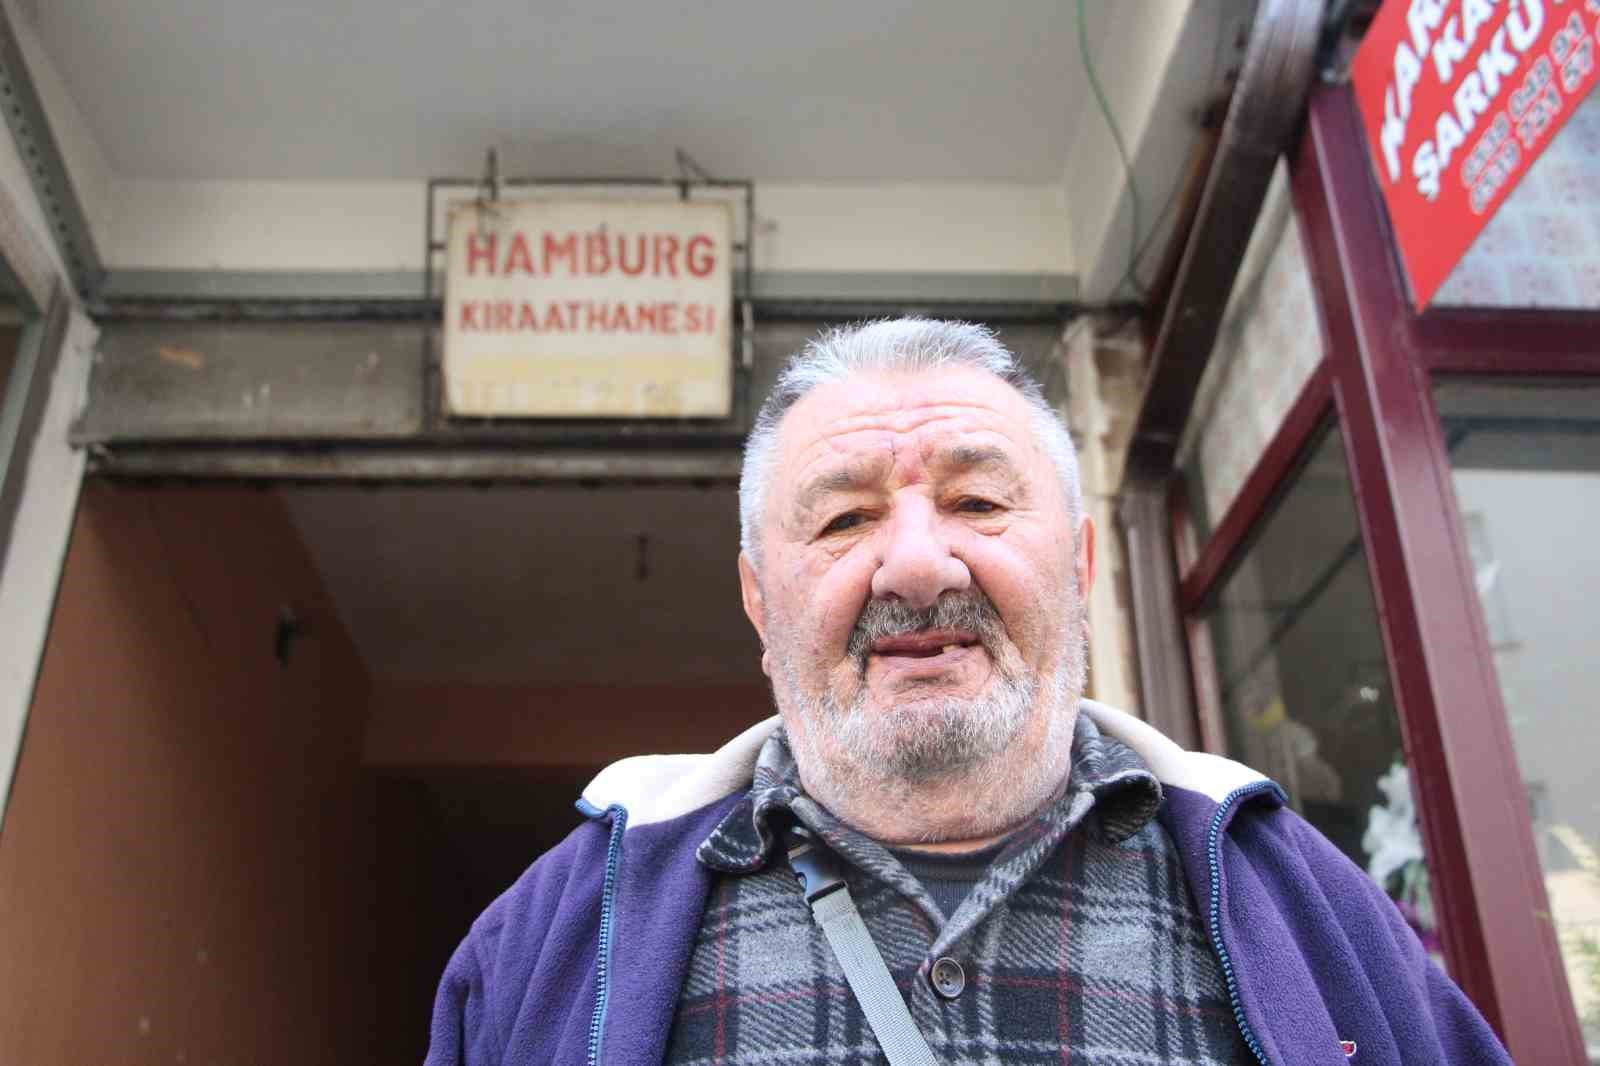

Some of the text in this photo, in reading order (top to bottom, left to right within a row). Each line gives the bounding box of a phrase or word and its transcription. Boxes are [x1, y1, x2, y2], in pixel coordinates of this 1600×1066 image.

[1432, 0, 1500, 84] KA
[1380, 0, 1449, 184] KAR
[464, 231, 716, 278] HAMBURG
[458, 302, 717, 335] KIRAATHANESI
